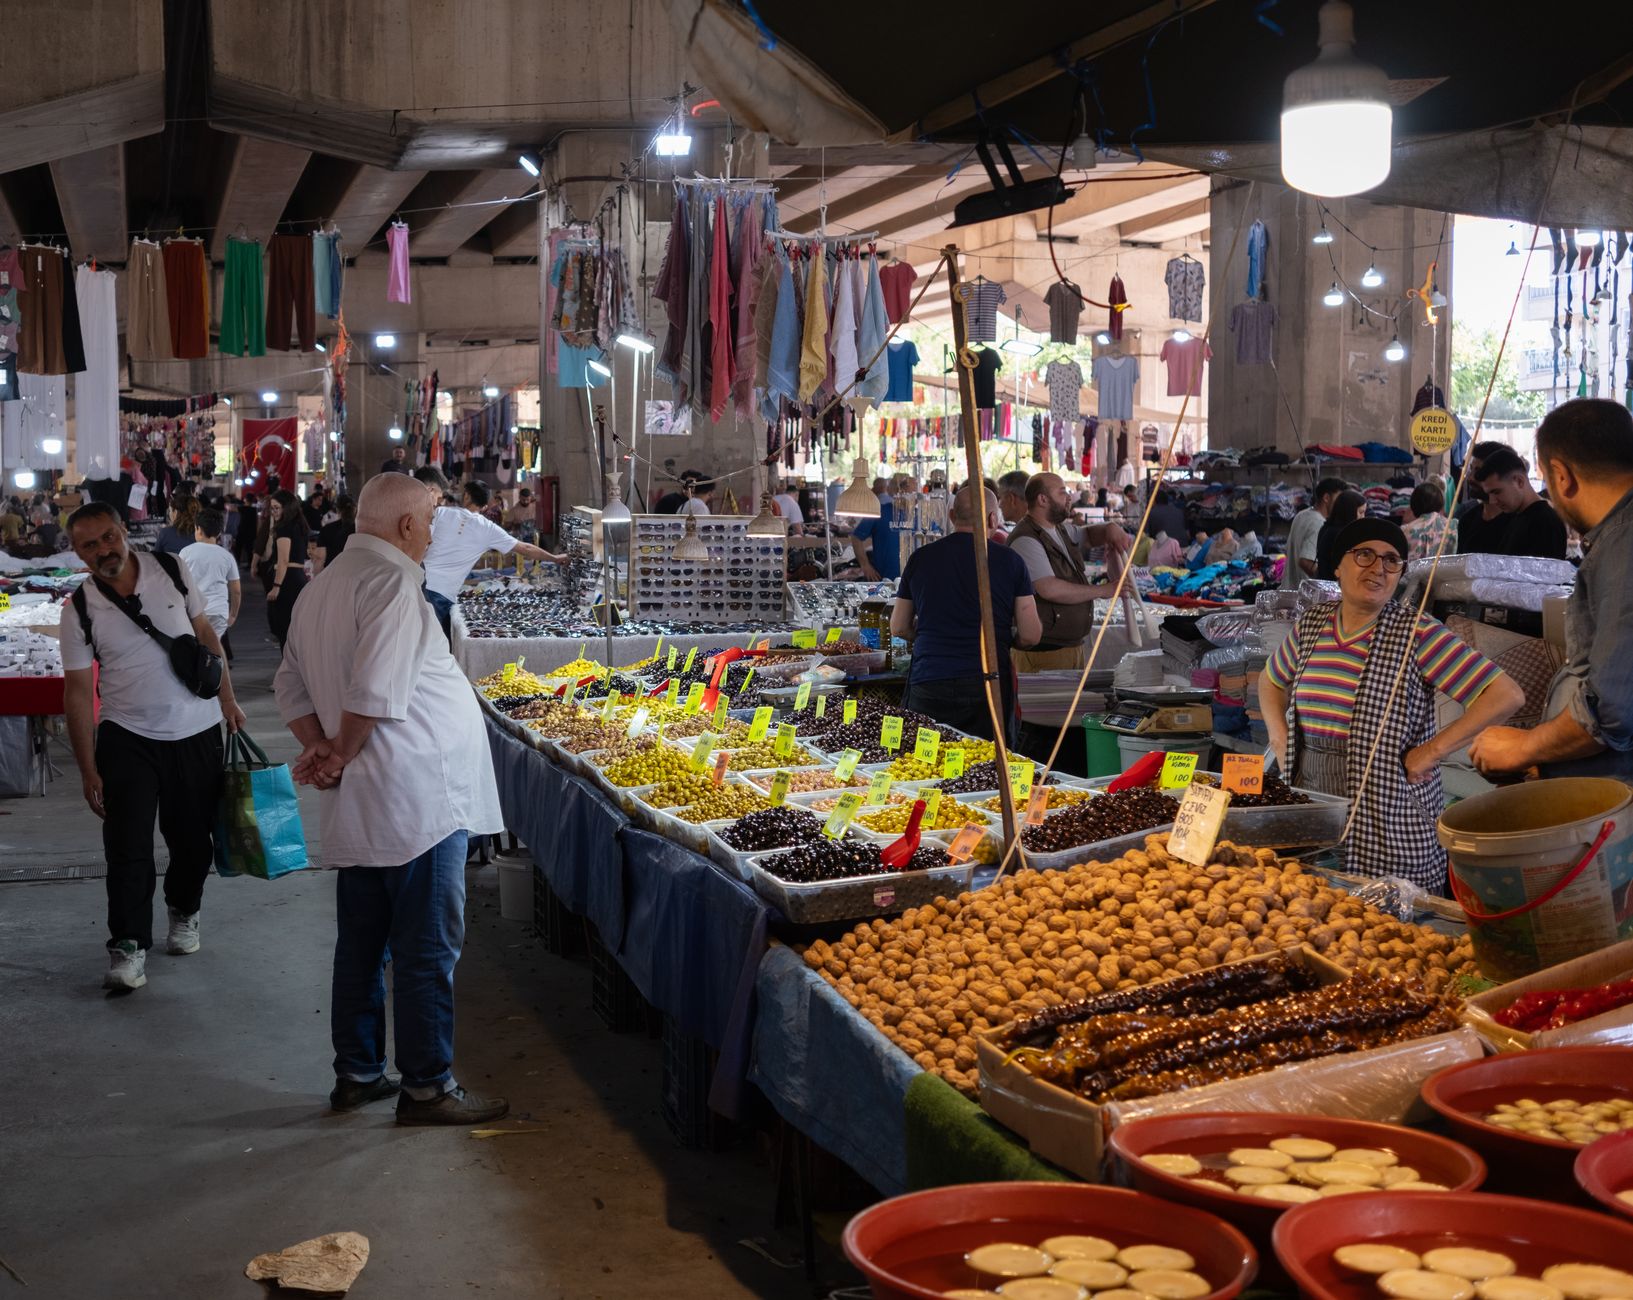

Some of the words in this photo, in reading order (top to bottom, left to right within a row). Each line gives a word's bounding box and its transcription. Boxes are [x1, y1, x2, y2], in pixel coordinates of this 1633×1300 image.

[1421, 415, 1448, 424] KREDİ
[1420, 426, 1447, 435] KARTI
[921, 749, 933, 758] 100
[1174, 774, 1190, 782] 100
[1240, 777, 1259, 786] 100
